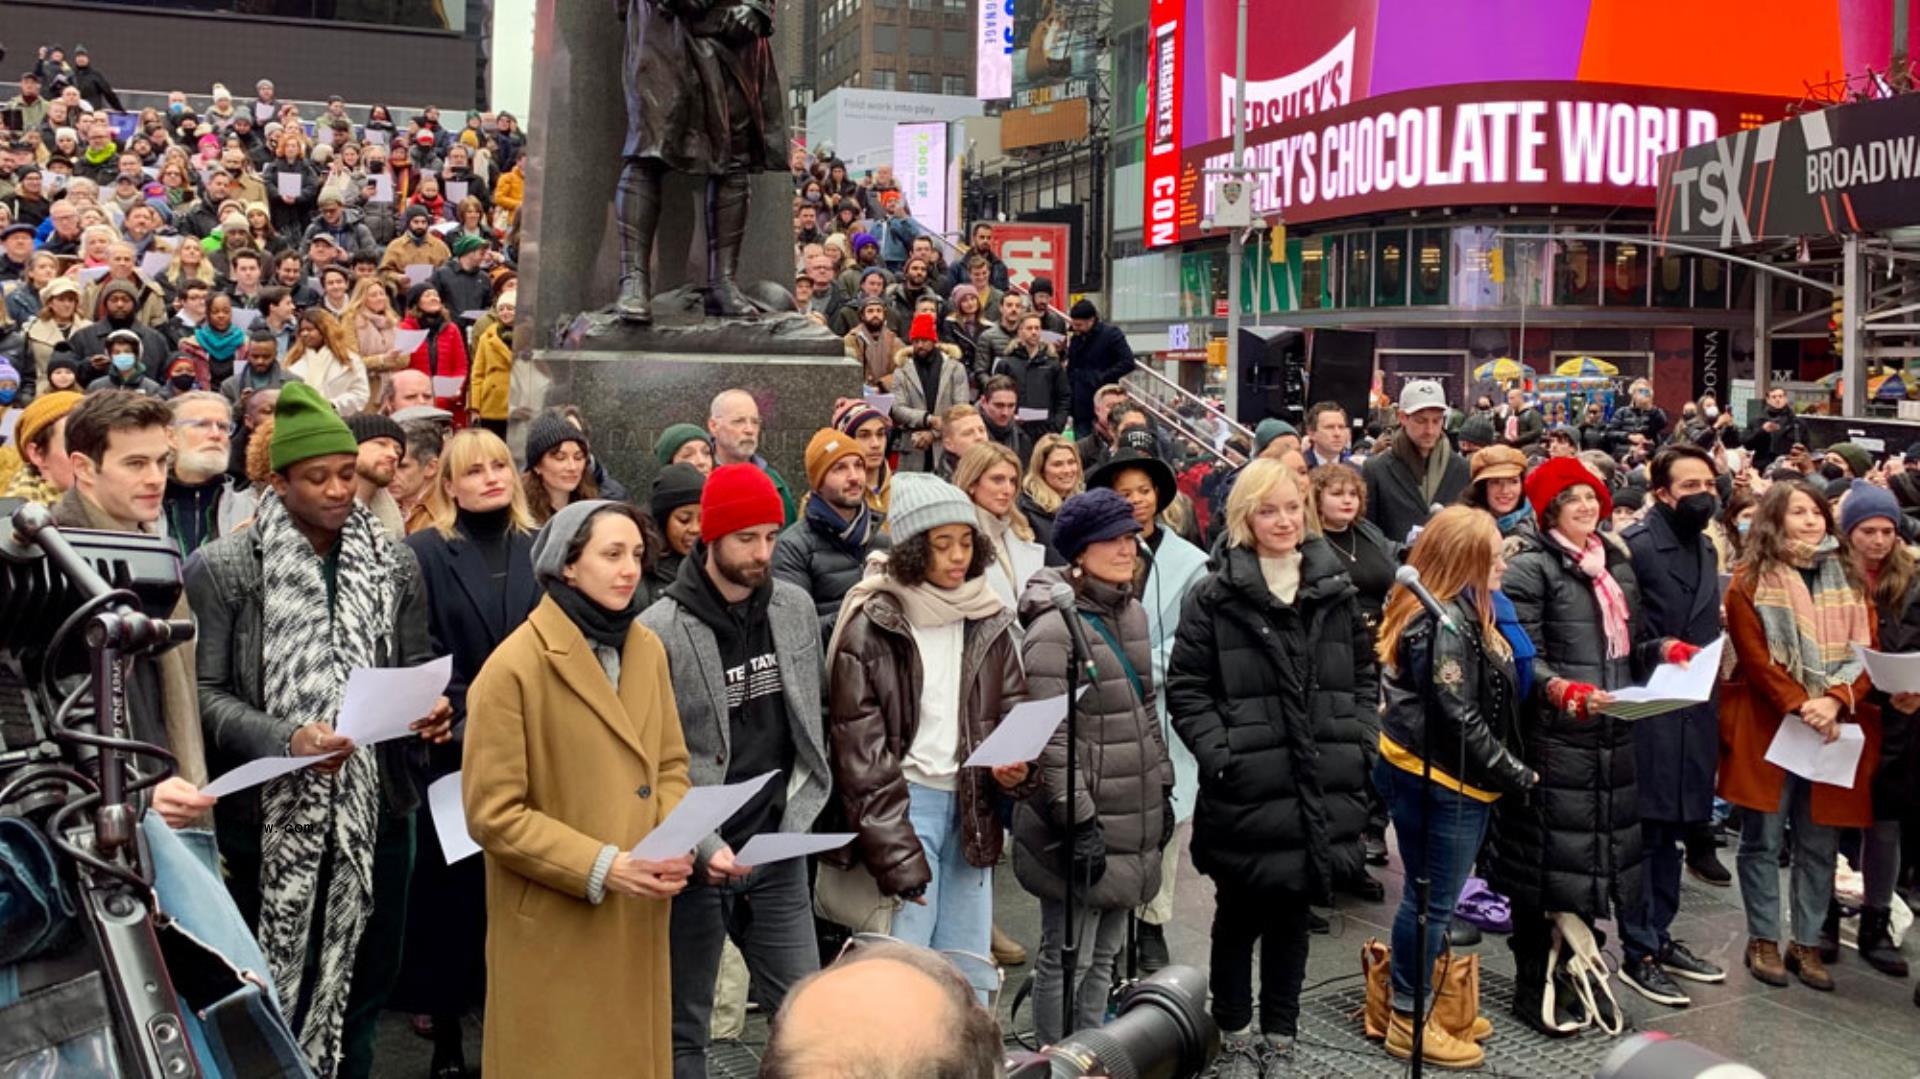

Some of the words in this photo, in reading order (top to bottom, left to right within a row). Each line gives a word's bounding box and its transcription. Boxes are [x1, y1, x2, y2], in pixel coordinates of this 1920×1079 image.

[867, 101, 892, 111] work
[915, 104, 935, 116] play
[1321, 101, 1549, 200] CHOCOLATE
[1672, 130, 1754, 248] TSX
